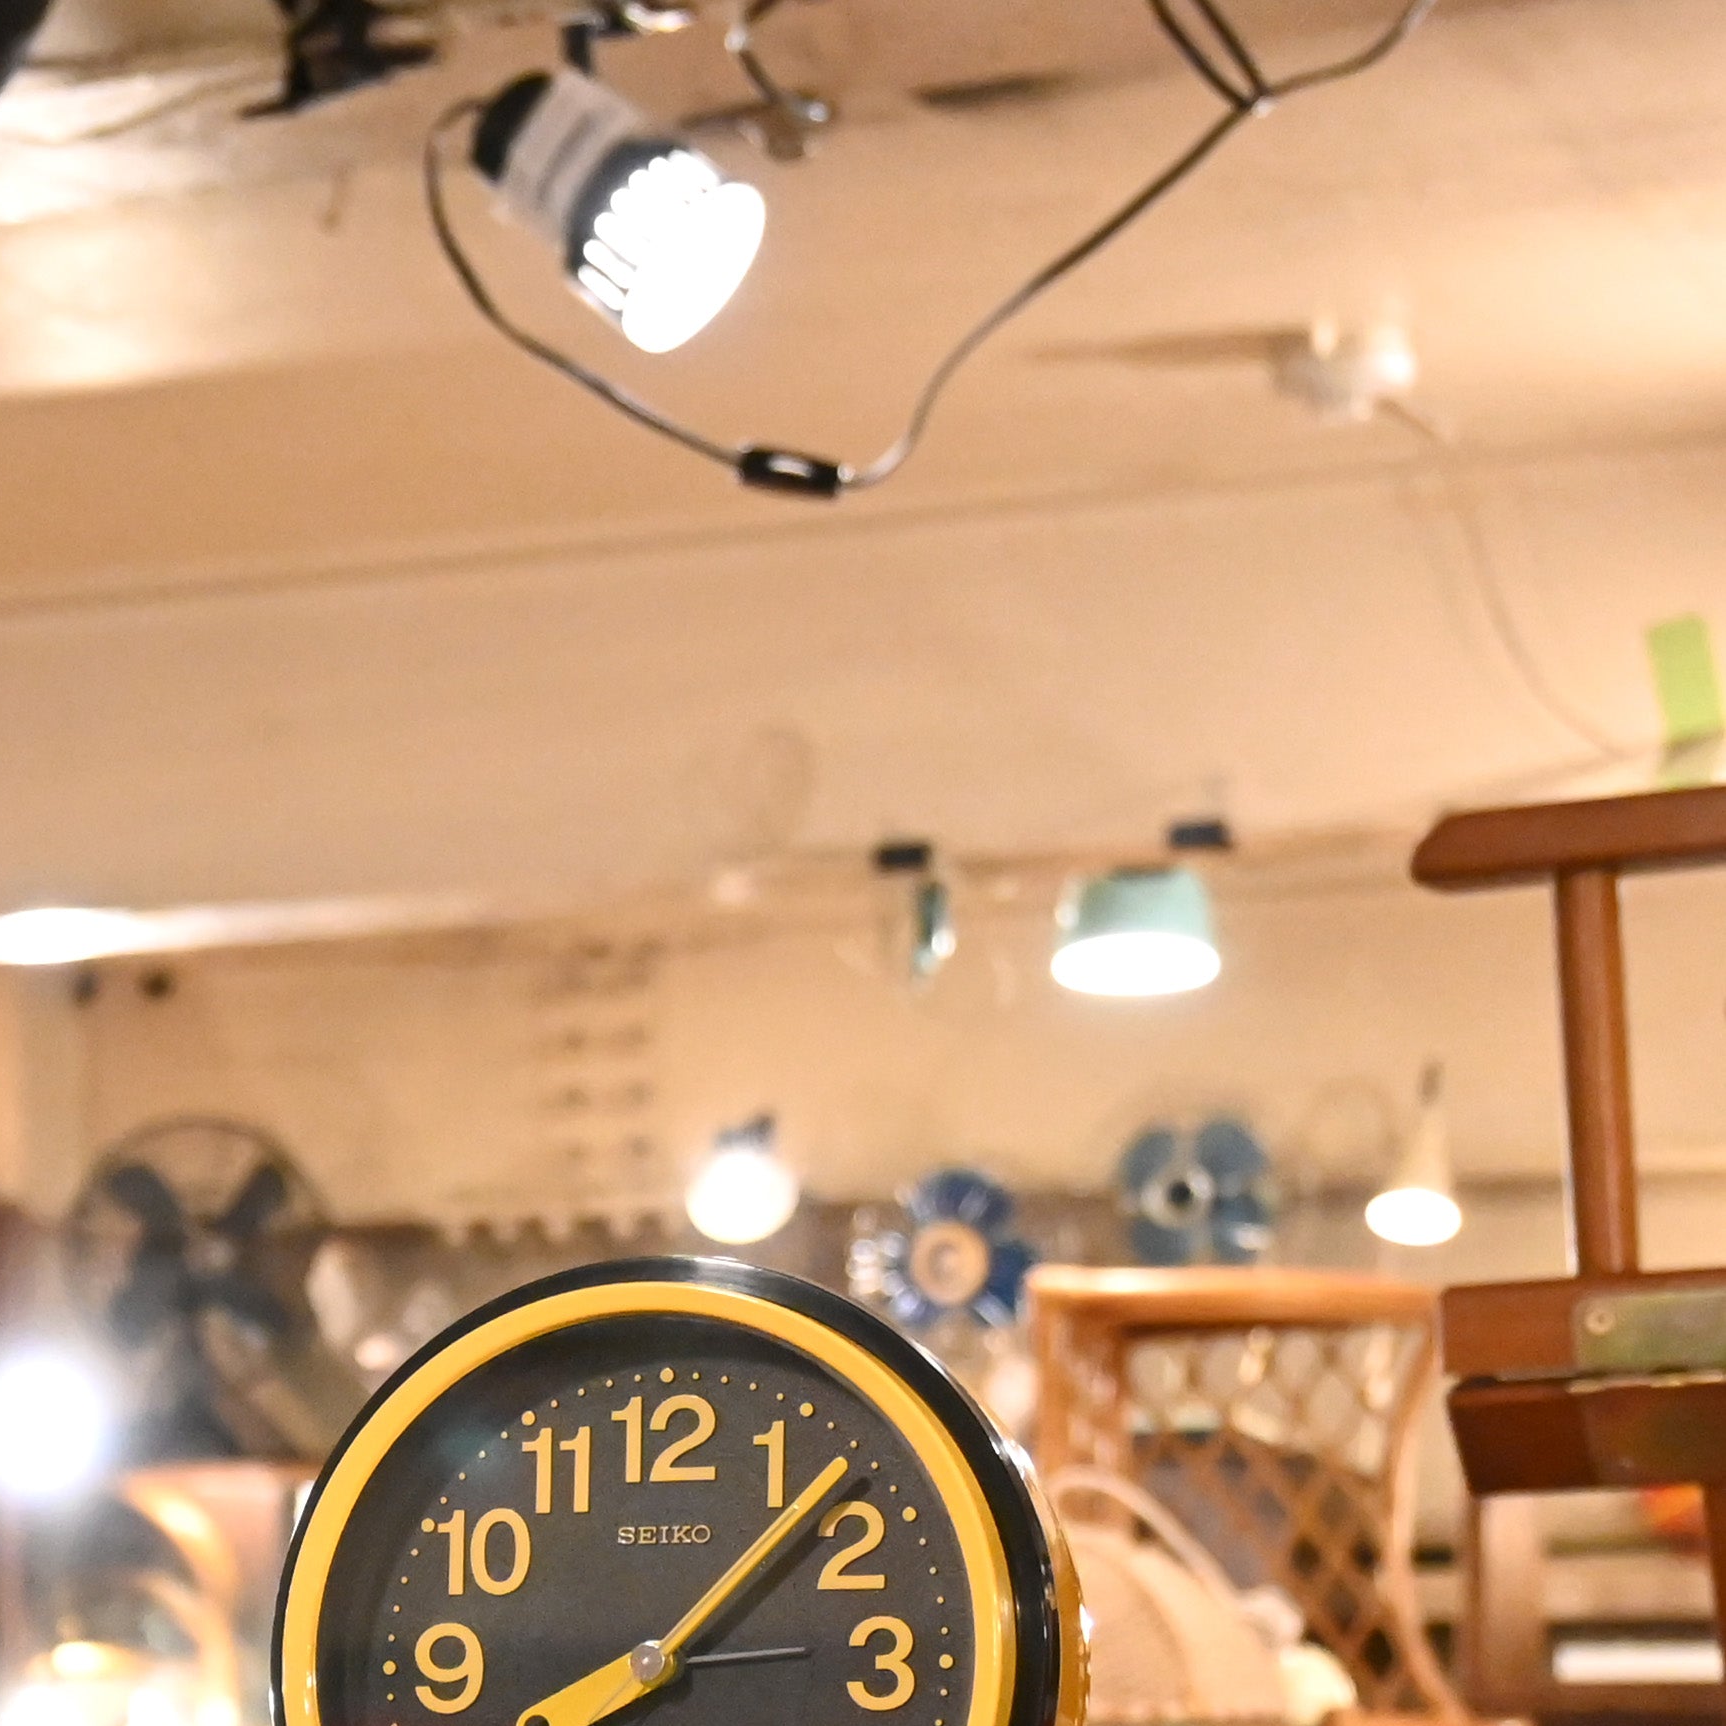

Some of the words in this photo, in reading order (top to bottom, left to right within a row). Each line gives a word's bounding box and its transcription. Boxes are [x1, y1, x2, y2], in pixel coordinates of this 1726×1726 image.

[521, 1426, 591, 1514] 11
[611, 1394, 716, 1484] 12
[753, 1420, 786, 1508] 1
[436, 1509, 531, 1596] 10
[617, 1524, 711, 1545] SEIKO
[816, 1501, 886, 1591] 2
[414, 1622, 484, 1714] 9
[846, 1616, 916, 1710] 3
